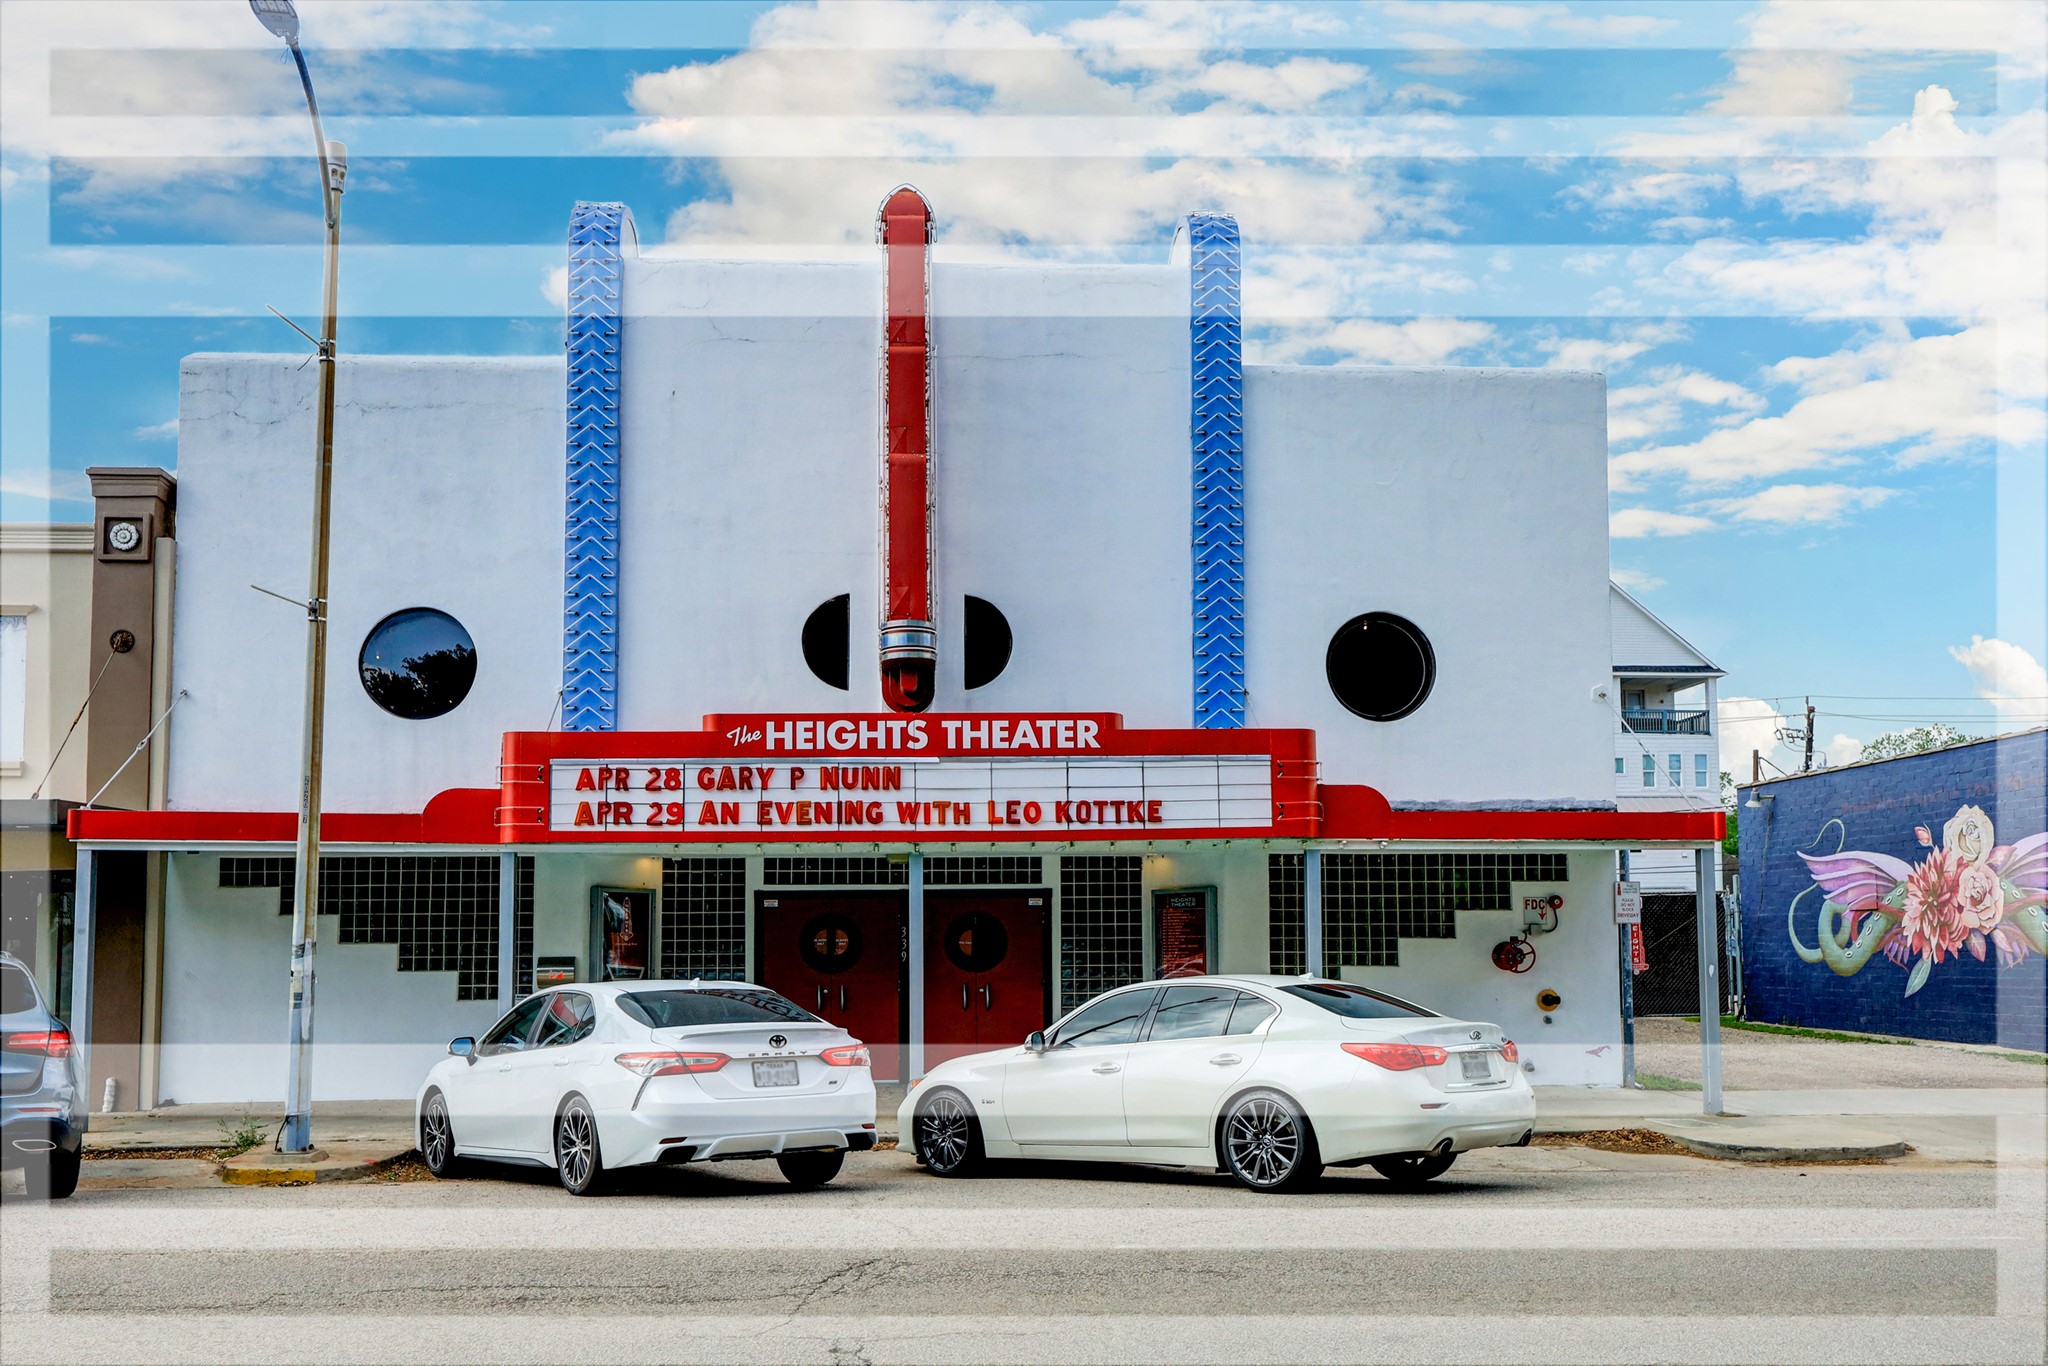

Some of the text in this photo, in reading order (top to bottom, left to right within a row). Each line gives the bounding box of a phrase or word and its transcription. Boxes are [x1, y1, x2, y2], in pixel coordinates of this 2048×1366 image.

[726, 719, 1101, 750] The HEIGHTS THEATER
[575, 766, 901, 791] APR 28 GARY P NUNN
[574, 800, 1163, 826] APR 29 AN EVENING WITH LEO KOTTKE
[1524, 899, 1545, 910] FDC
